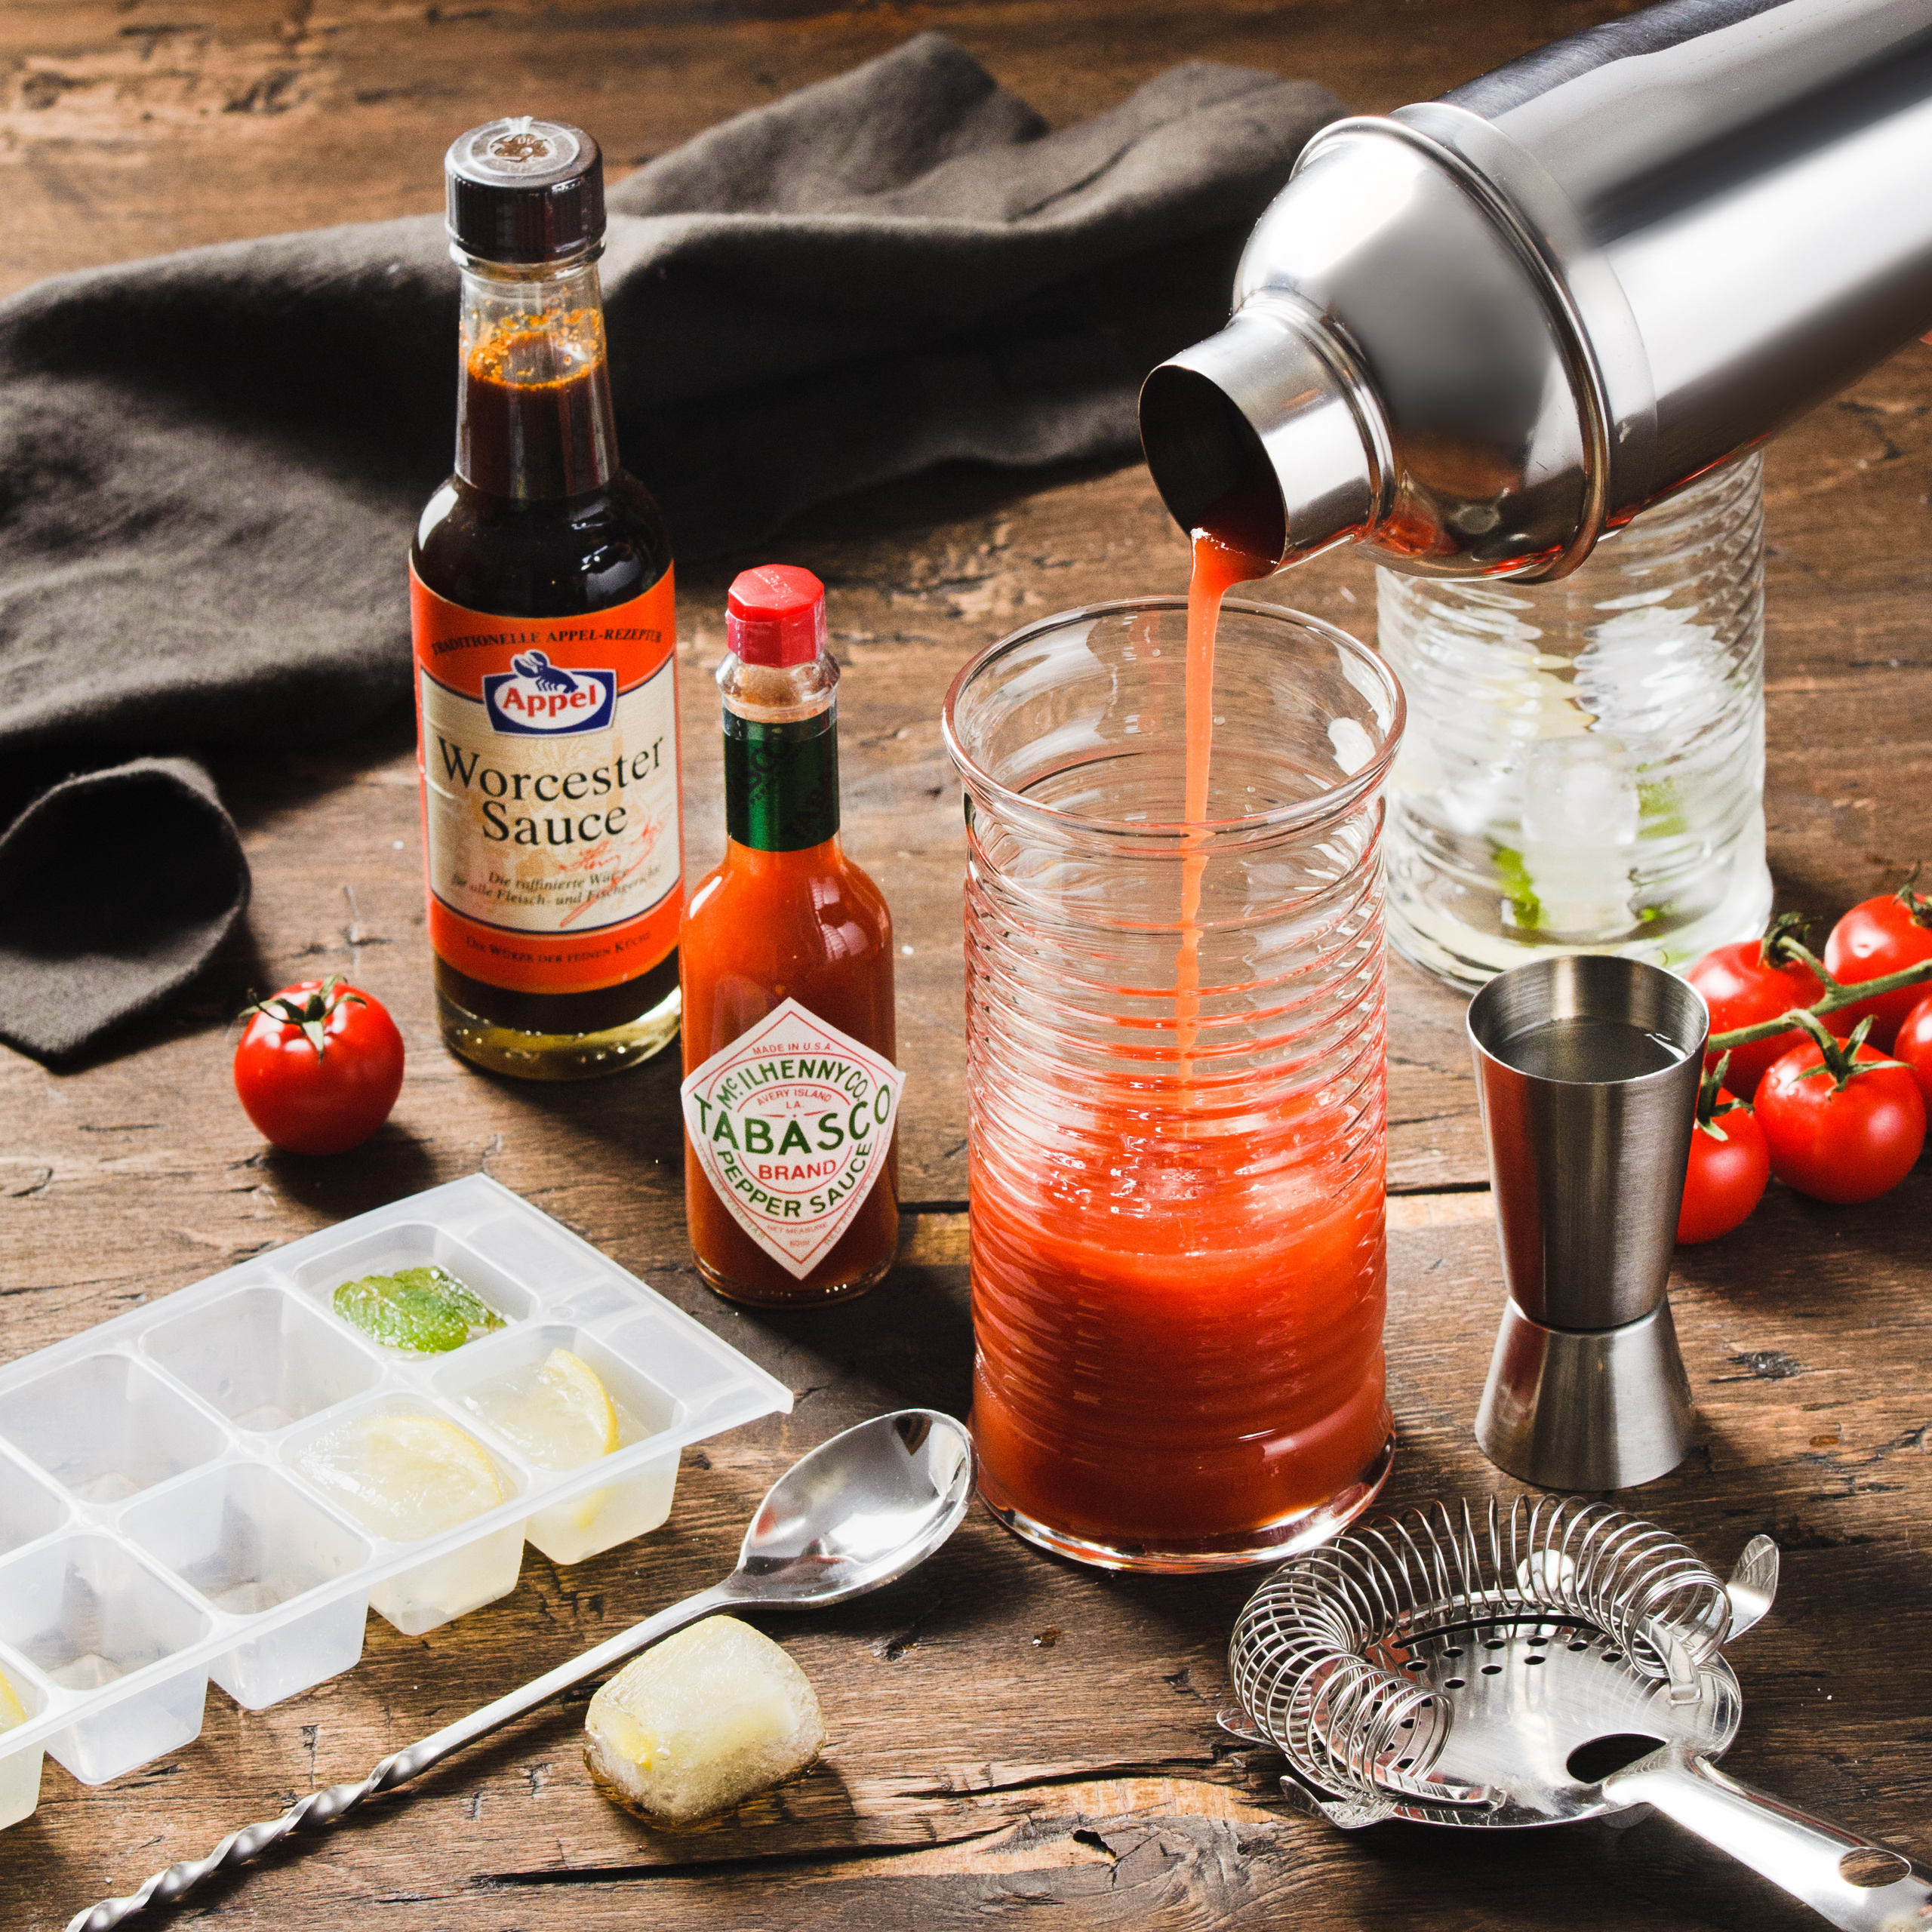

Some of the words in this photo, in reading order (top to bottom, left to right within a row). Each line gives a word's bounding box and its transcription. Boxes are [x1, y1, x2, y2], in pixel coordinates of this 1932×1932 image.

[432, 632, 540, 655] TRADITIONELLE
[502, 685, 598, 718] Appel
[438, 735, 663, 802] Worcester
[482, 799, 628, 846] Sauce
[752, 1043, 785, 1055] MADE
[757, 1088, 790, 1106] AVERY
[794, 1088, 832, 1103] ISLAND
[694, 1084, 891, 1156] TABASCO
[717, 1150, 801, 1218] PEPPER
[810, 1141, 873, 1214] SAUCE
[758, 1159, 837, 1180] BRAND
